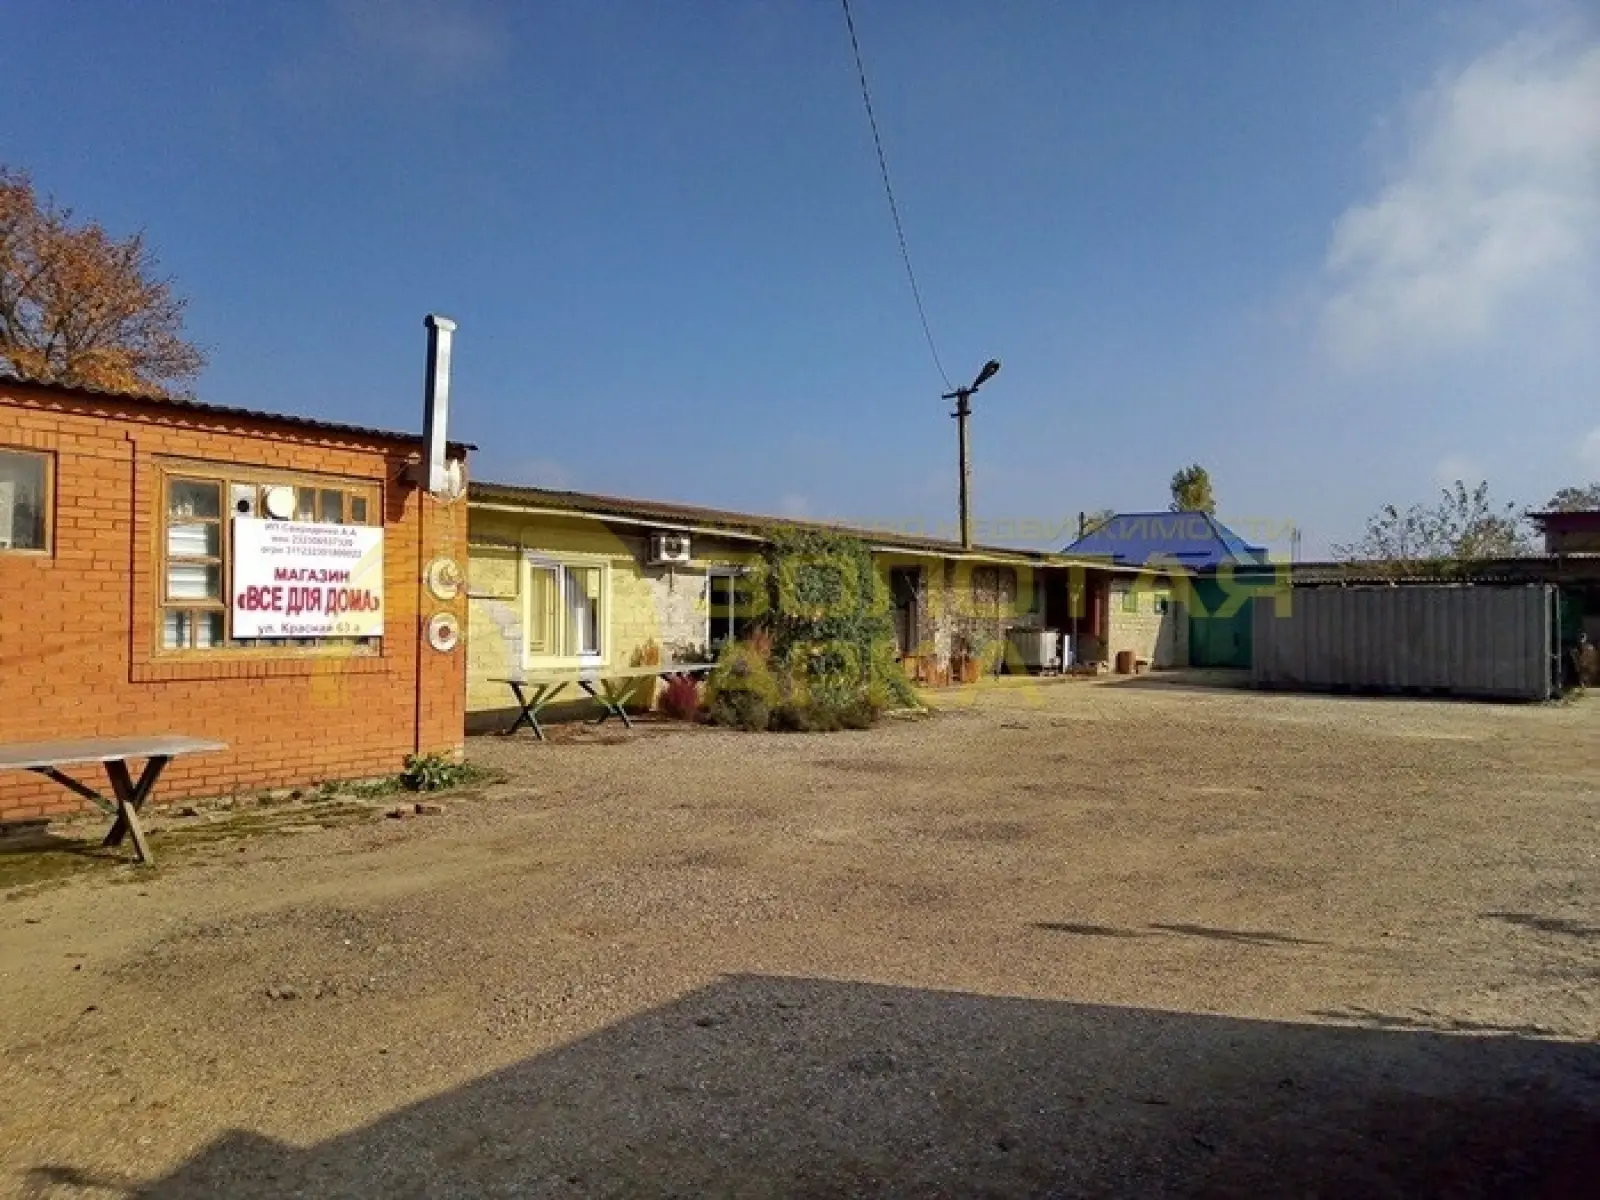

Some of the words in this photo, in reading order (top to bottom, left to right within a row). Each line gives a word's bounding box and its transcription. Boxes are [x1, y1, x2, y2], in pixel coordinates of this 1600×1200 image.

[274, 567, 350, 583] МАГАЗИН
[237, 585, 284, 611] «ВСЕ
[286, 586, 322, 616] ДЛЯ
[324, 587, 380, 617] ДОМА»
[281, 622, 333, 636] Красная
